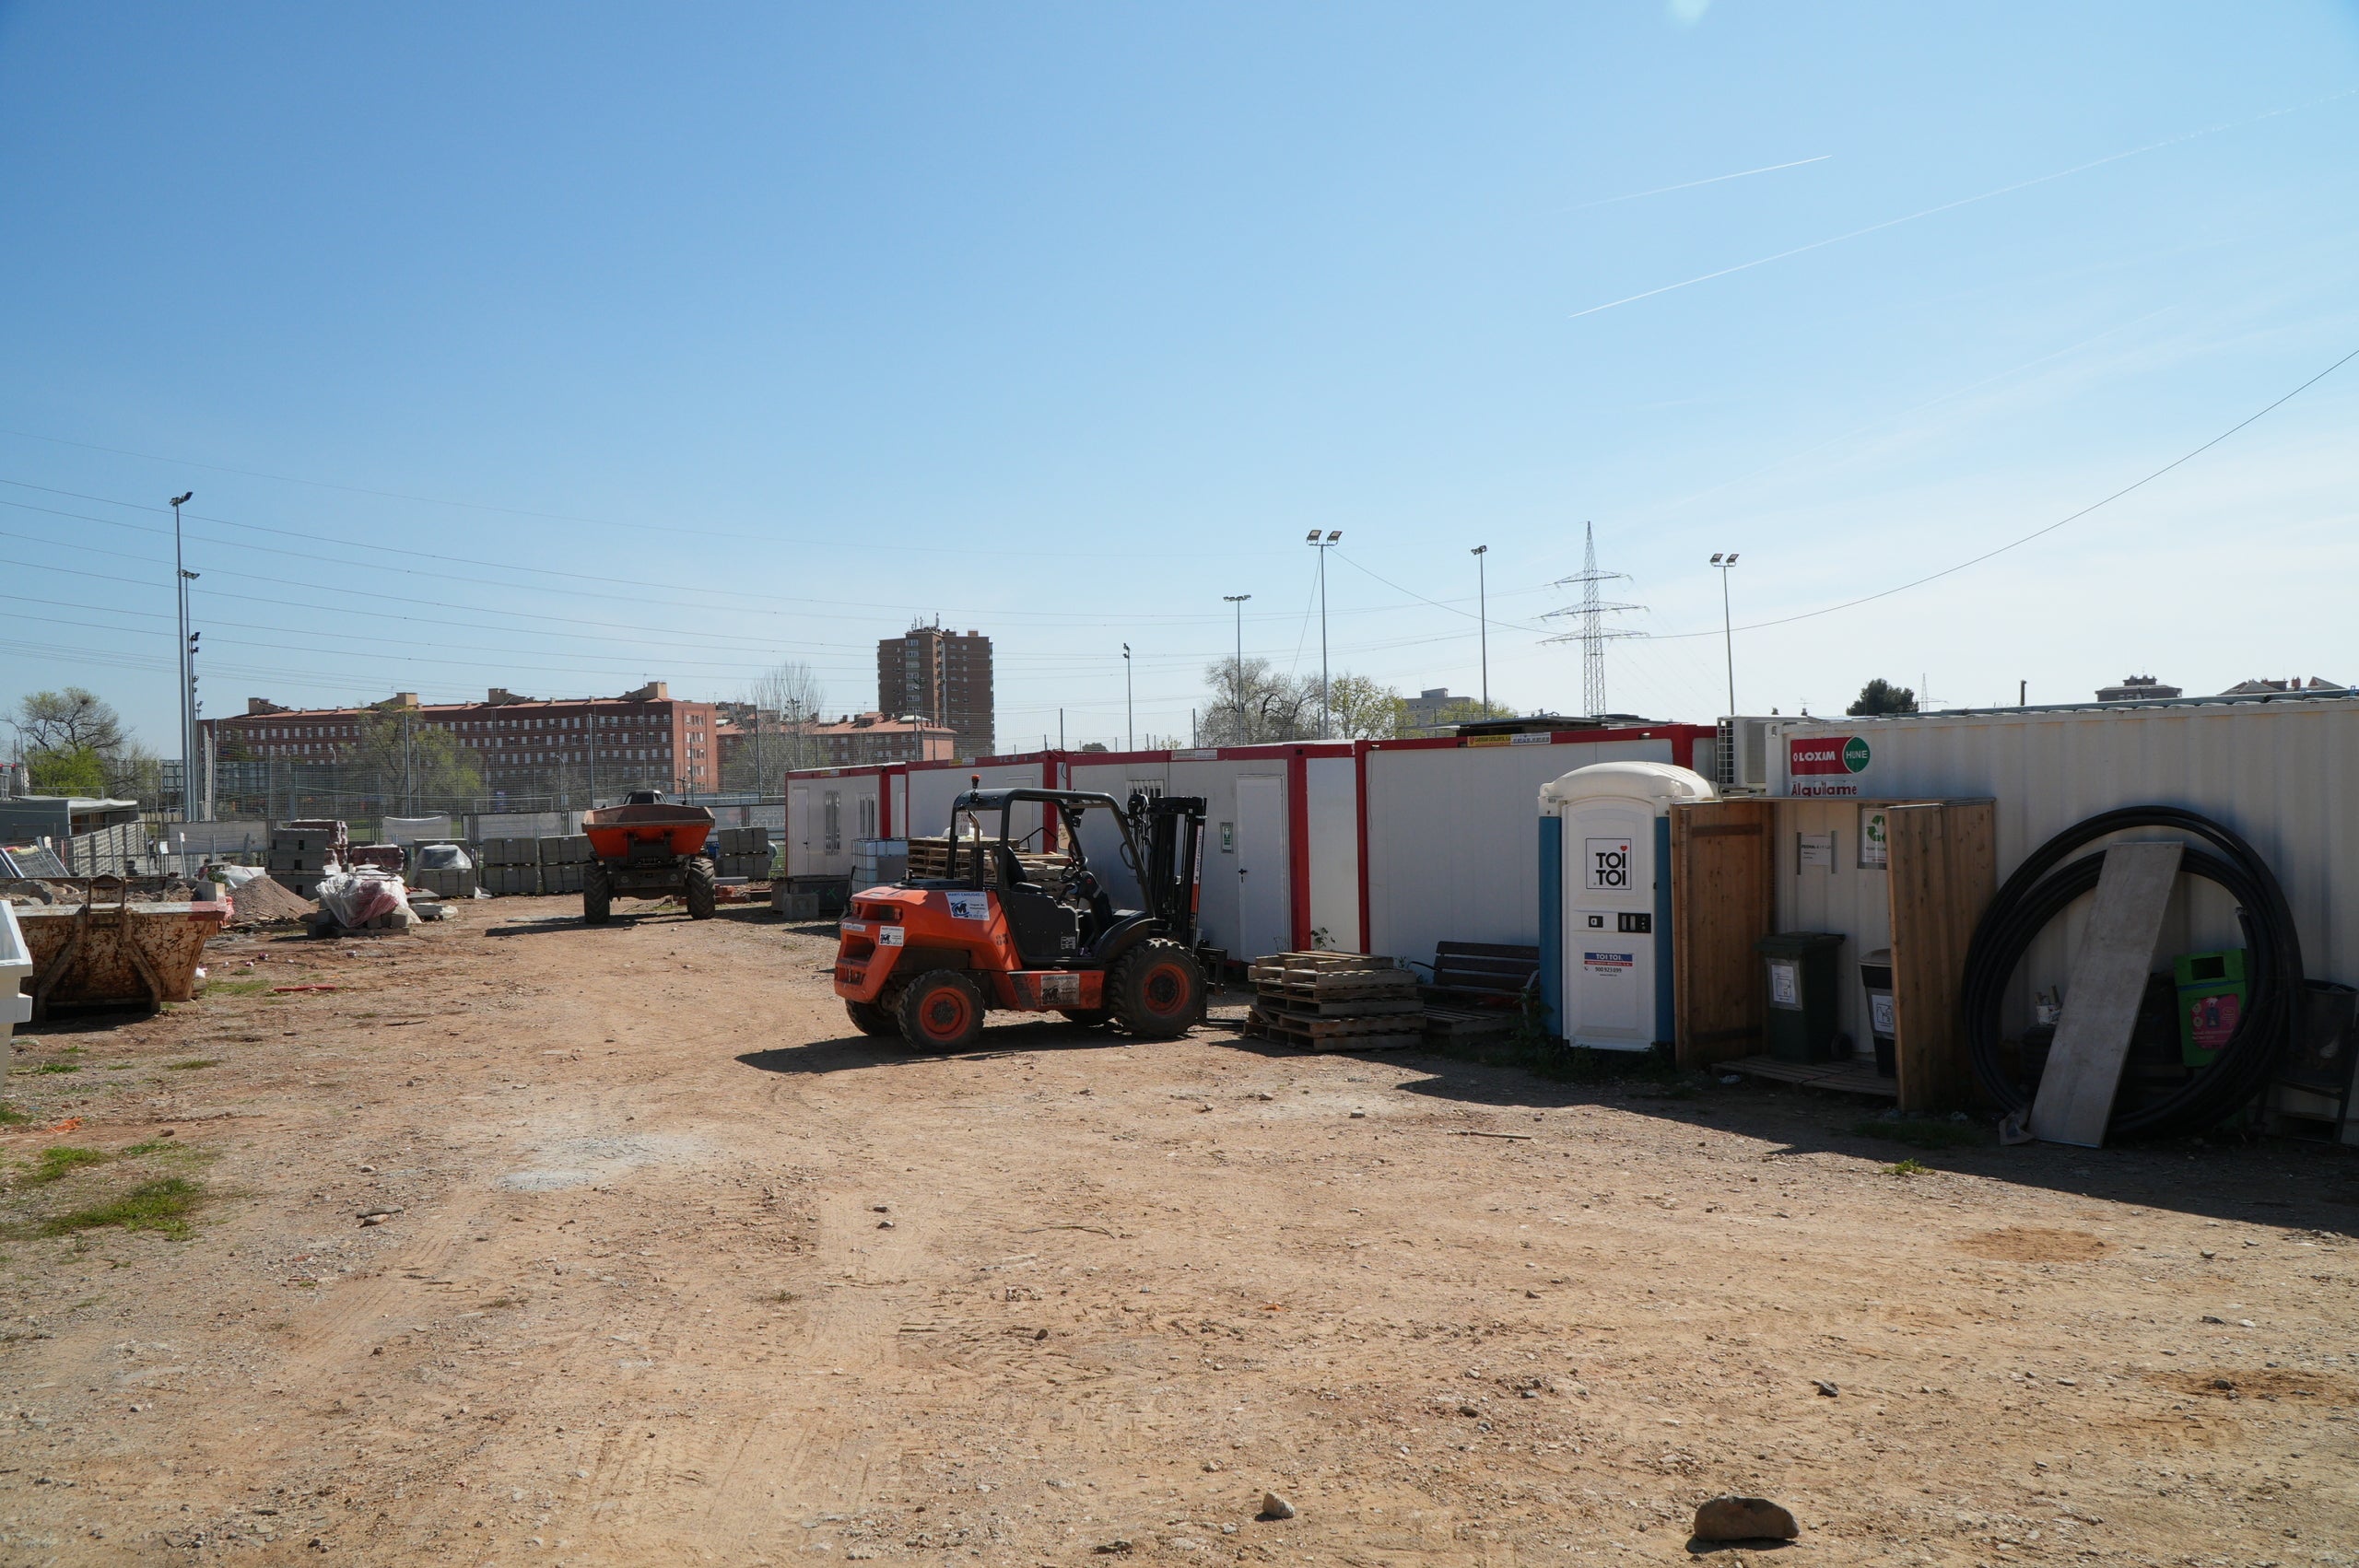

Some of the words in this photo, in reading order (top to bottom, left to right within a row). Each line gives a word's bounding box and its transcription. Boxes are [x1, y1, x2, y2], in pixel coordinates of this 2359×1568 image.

[1846, 750, 1868, 759] HUNE
[1596, 852, 1626, 869] TOI
[1596, 870, 1626, 886] TOI
